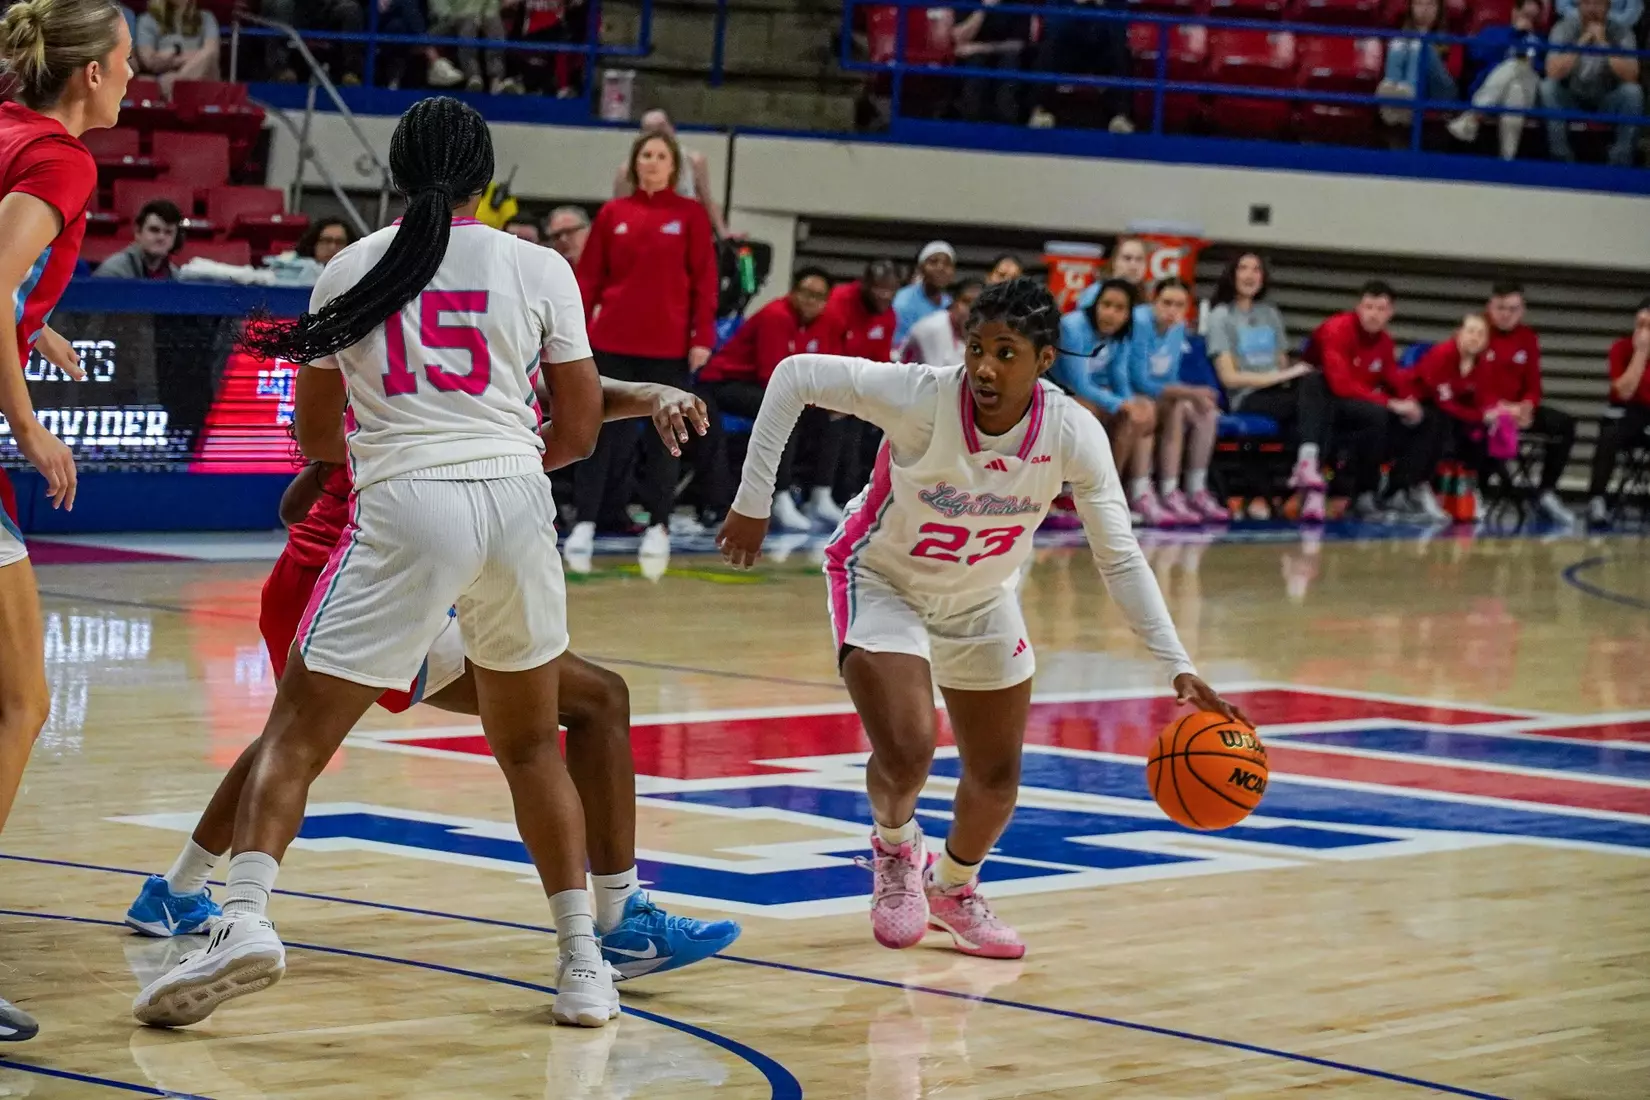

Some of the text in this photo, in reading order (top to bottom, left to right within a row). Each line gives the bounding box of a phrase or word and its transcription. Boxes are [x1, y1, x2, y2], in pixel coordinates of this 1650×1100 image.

[381, 290, 491, 397] 15
[0, 410, 169, 446] OVIDER
[909, 522, 1026, 566] 23
[1227, 767, 1266, 796] NCA
